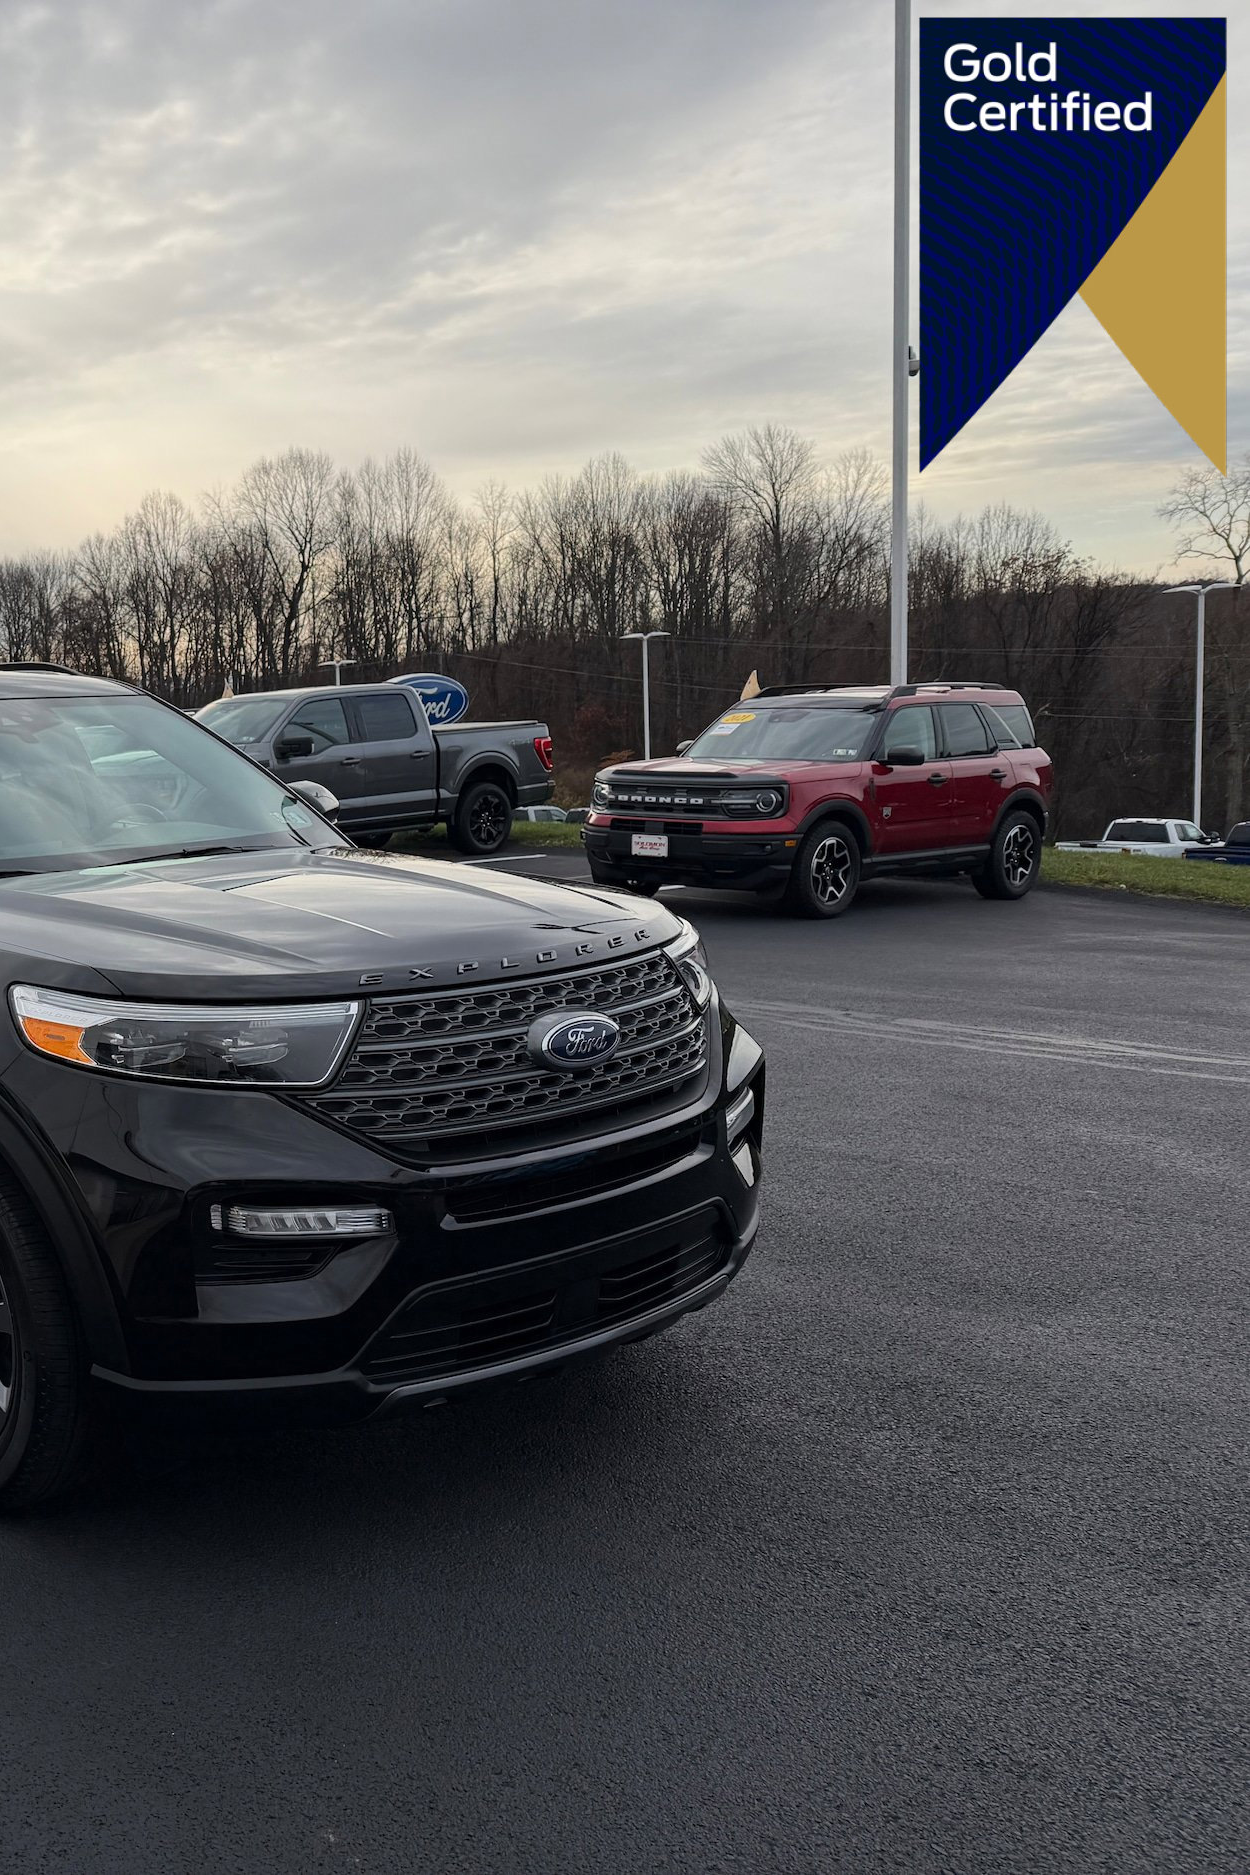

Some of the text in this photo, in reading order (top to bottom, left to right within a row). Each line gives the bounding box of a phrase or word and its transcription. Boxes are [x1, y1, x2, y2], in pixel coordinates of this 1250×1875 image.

[617, 794, 704, 805] BRONCO
[359, 928, 651, 986] EXPLORER
[565, 1026, 608, 1056] Ford
